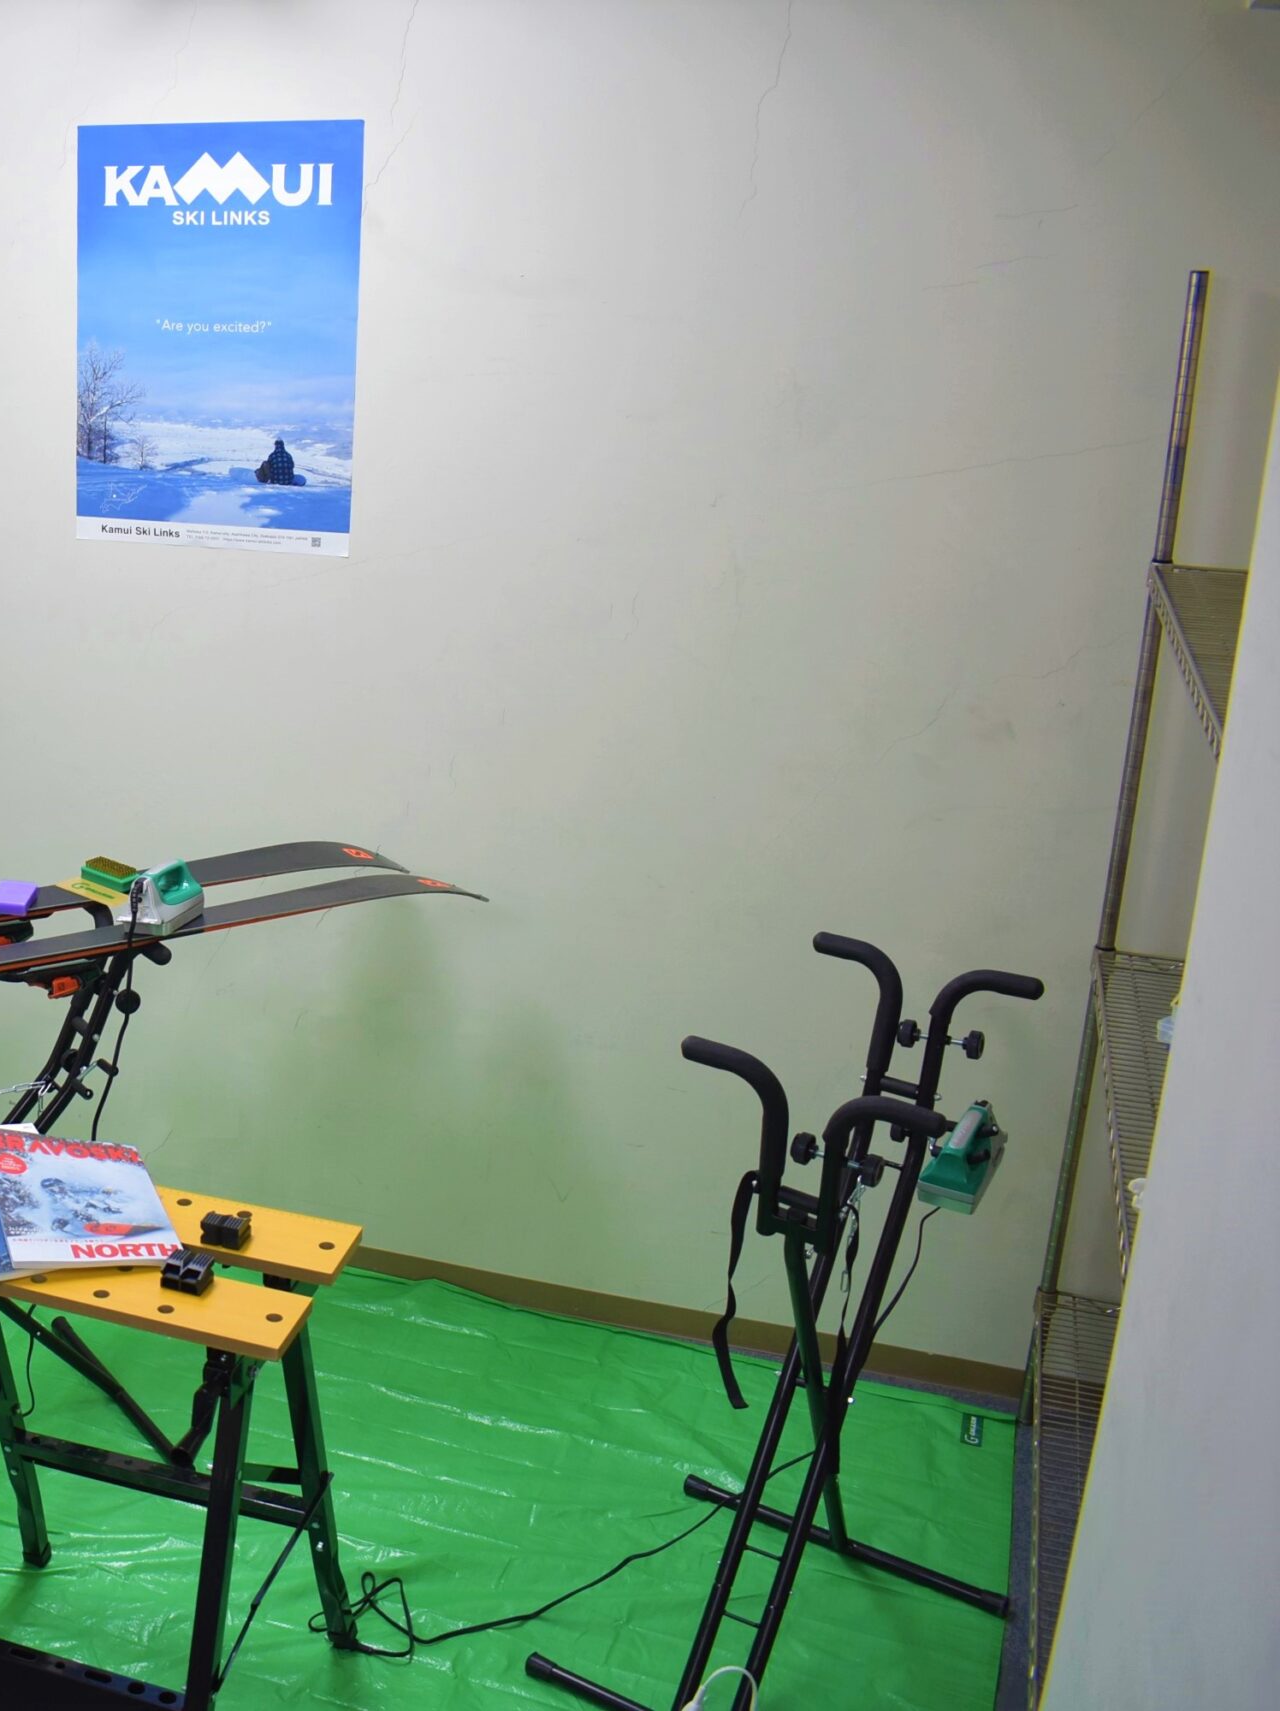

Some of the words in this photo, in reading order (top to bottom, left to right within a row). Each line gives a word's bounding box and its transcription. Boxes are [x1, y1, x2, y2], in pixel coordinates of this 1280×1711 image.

[103, 151, 334, 207] KAMUI
[172, 210, 205, 226] SKI
[211, 210, 270, 226] LINKS
[187, 322, 209, 335] you
[101, 524, 132, 535] Kamui
[135, 526, 151, 536] Ski
[153, 527, 181, 538] Links
[70, 1243, 179, 1259] NORTH
